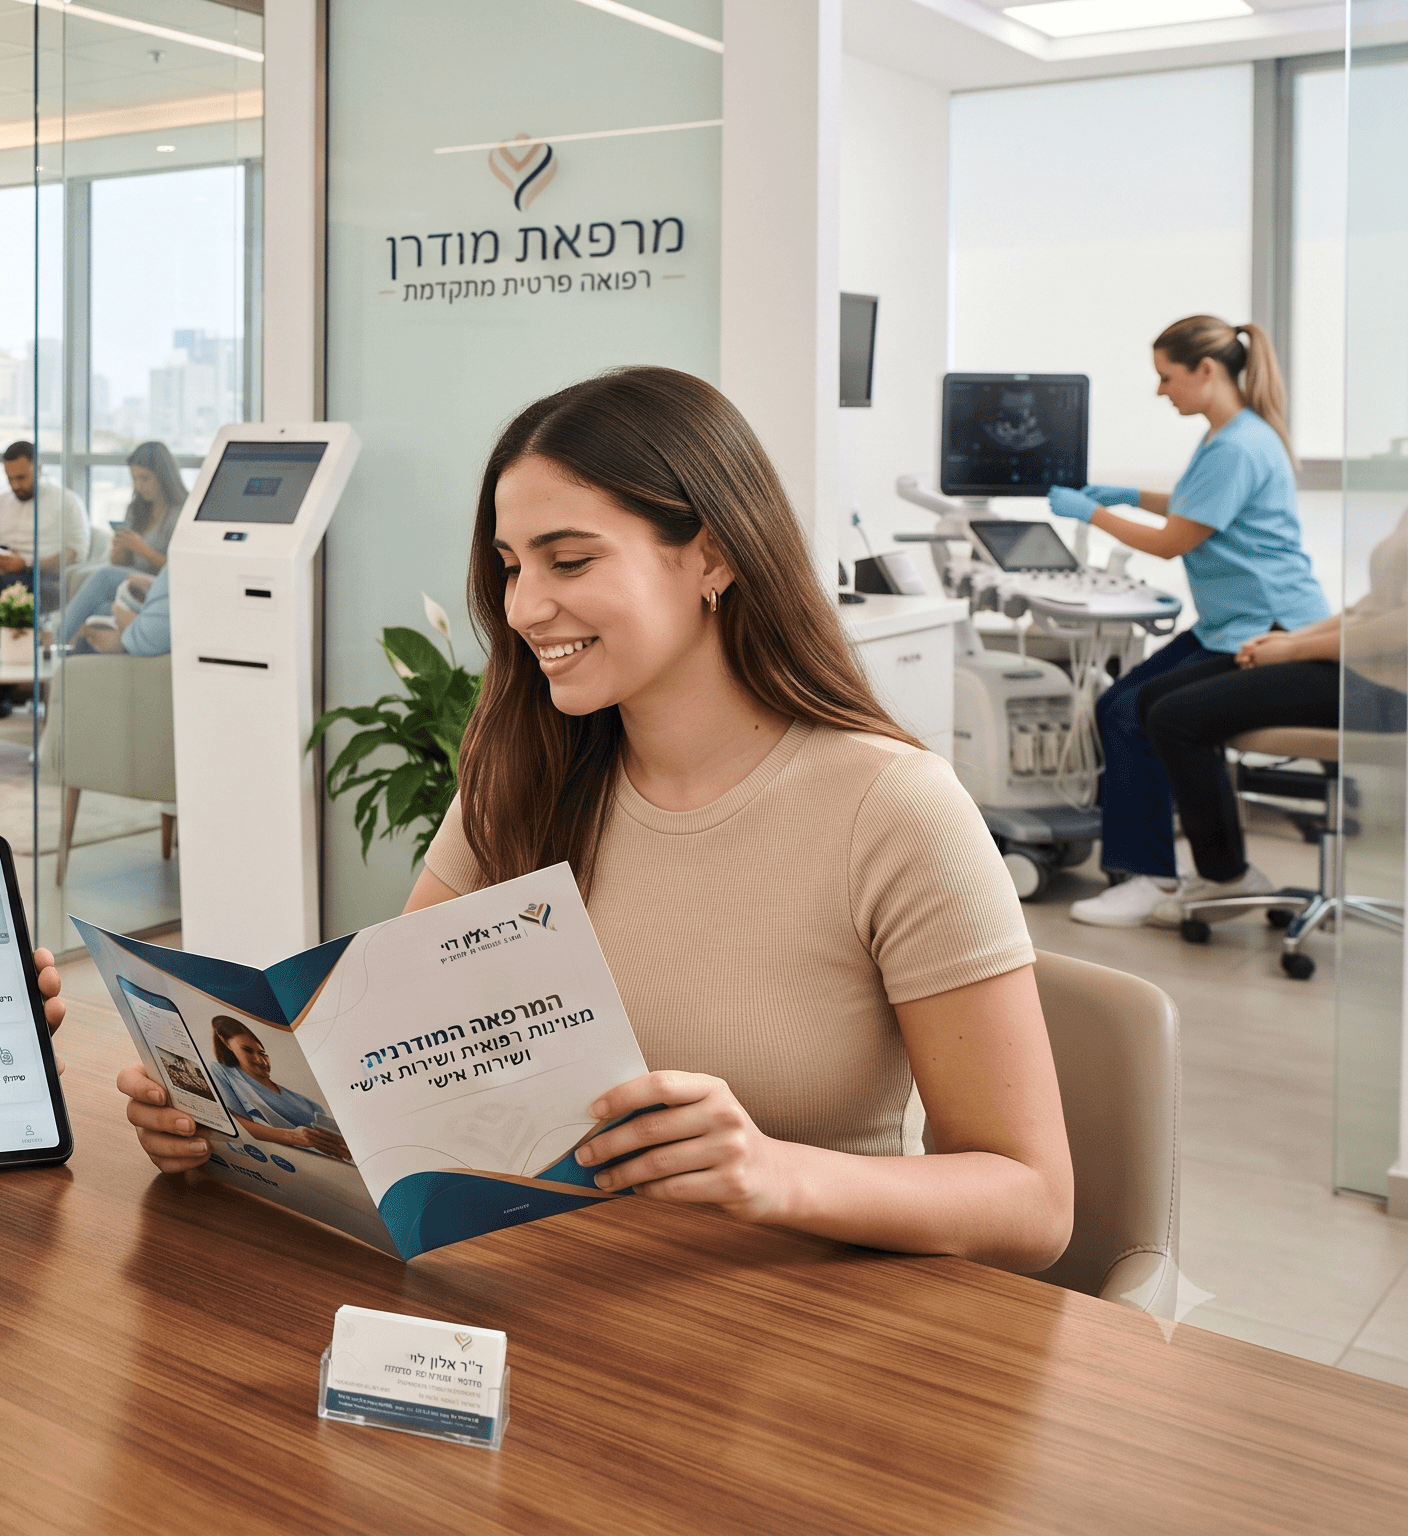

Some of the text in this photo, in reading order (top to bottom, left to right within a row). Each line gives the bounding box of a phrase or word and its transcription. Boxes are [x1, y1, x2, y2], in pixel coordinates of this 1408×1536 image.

[386, 216, 684, 281] מרפאת מודרן
[403, 269, 651, 305] רפואה פרטית מתקדמת
[468, 994, 564, 1035] המרפאה
[527, 1008, 595, 1040] מצוינות
[460, 1030, 523, 1060] רפואית
[397, 1050, 456, 1080] ושירות
[427, 1048, 532, 1089] ושירות אישי
[410, 1352, 426, 1365] לוי
[430, 1355, 456, 1371] אלון
